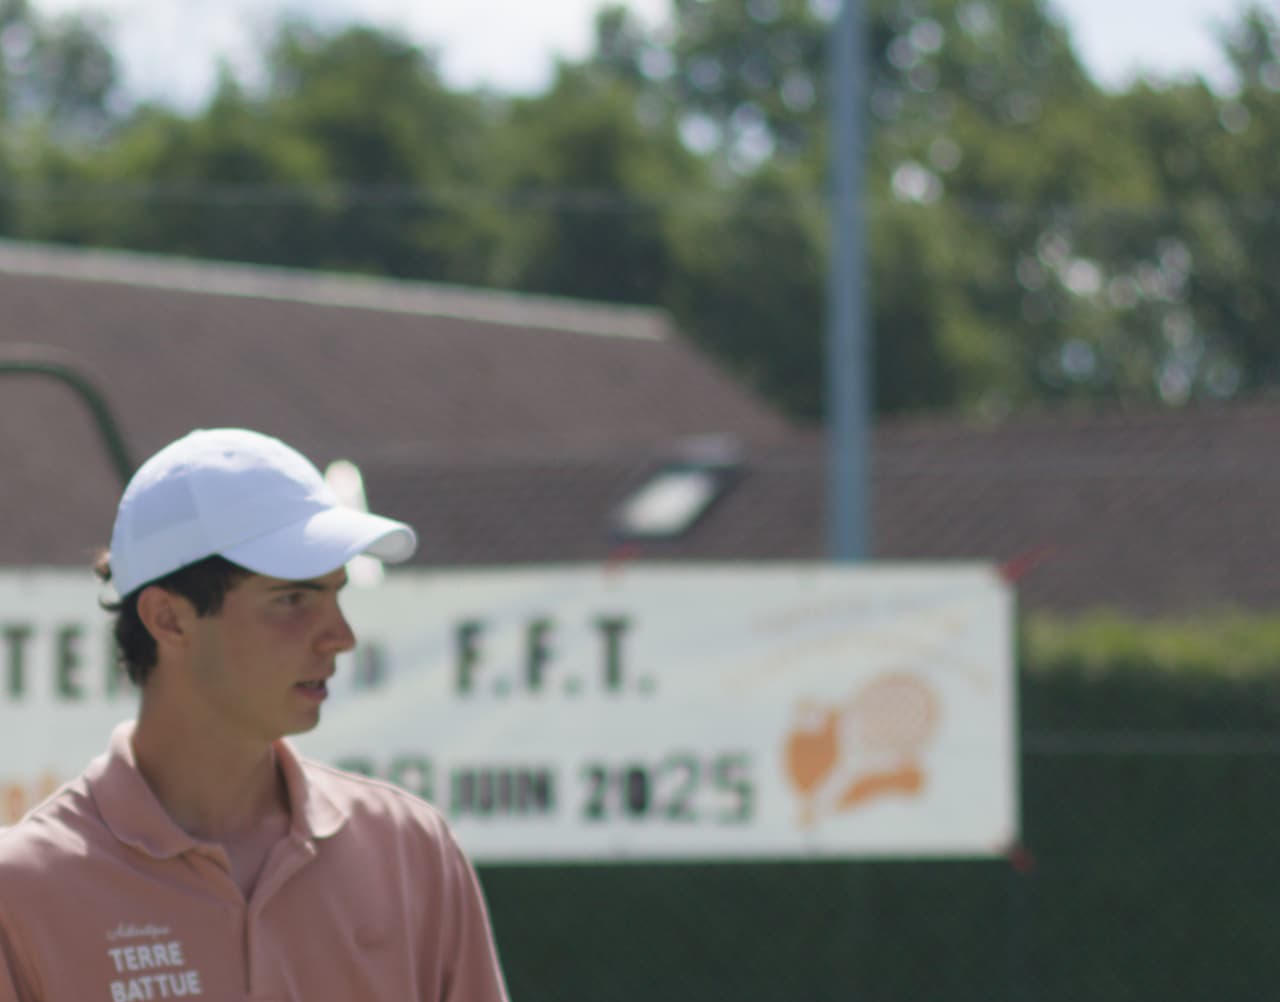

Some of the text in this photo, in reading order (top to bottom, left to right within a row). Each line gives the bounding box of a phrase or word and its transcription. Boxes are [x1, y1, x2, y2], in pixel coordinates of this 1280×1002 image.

[453, 615, 656, 695] F.F.T.
[449, 765, 552, 819] JUIN
[580, 757, 756, 822] 2025
[107, 941, 184, 972] TERRE
